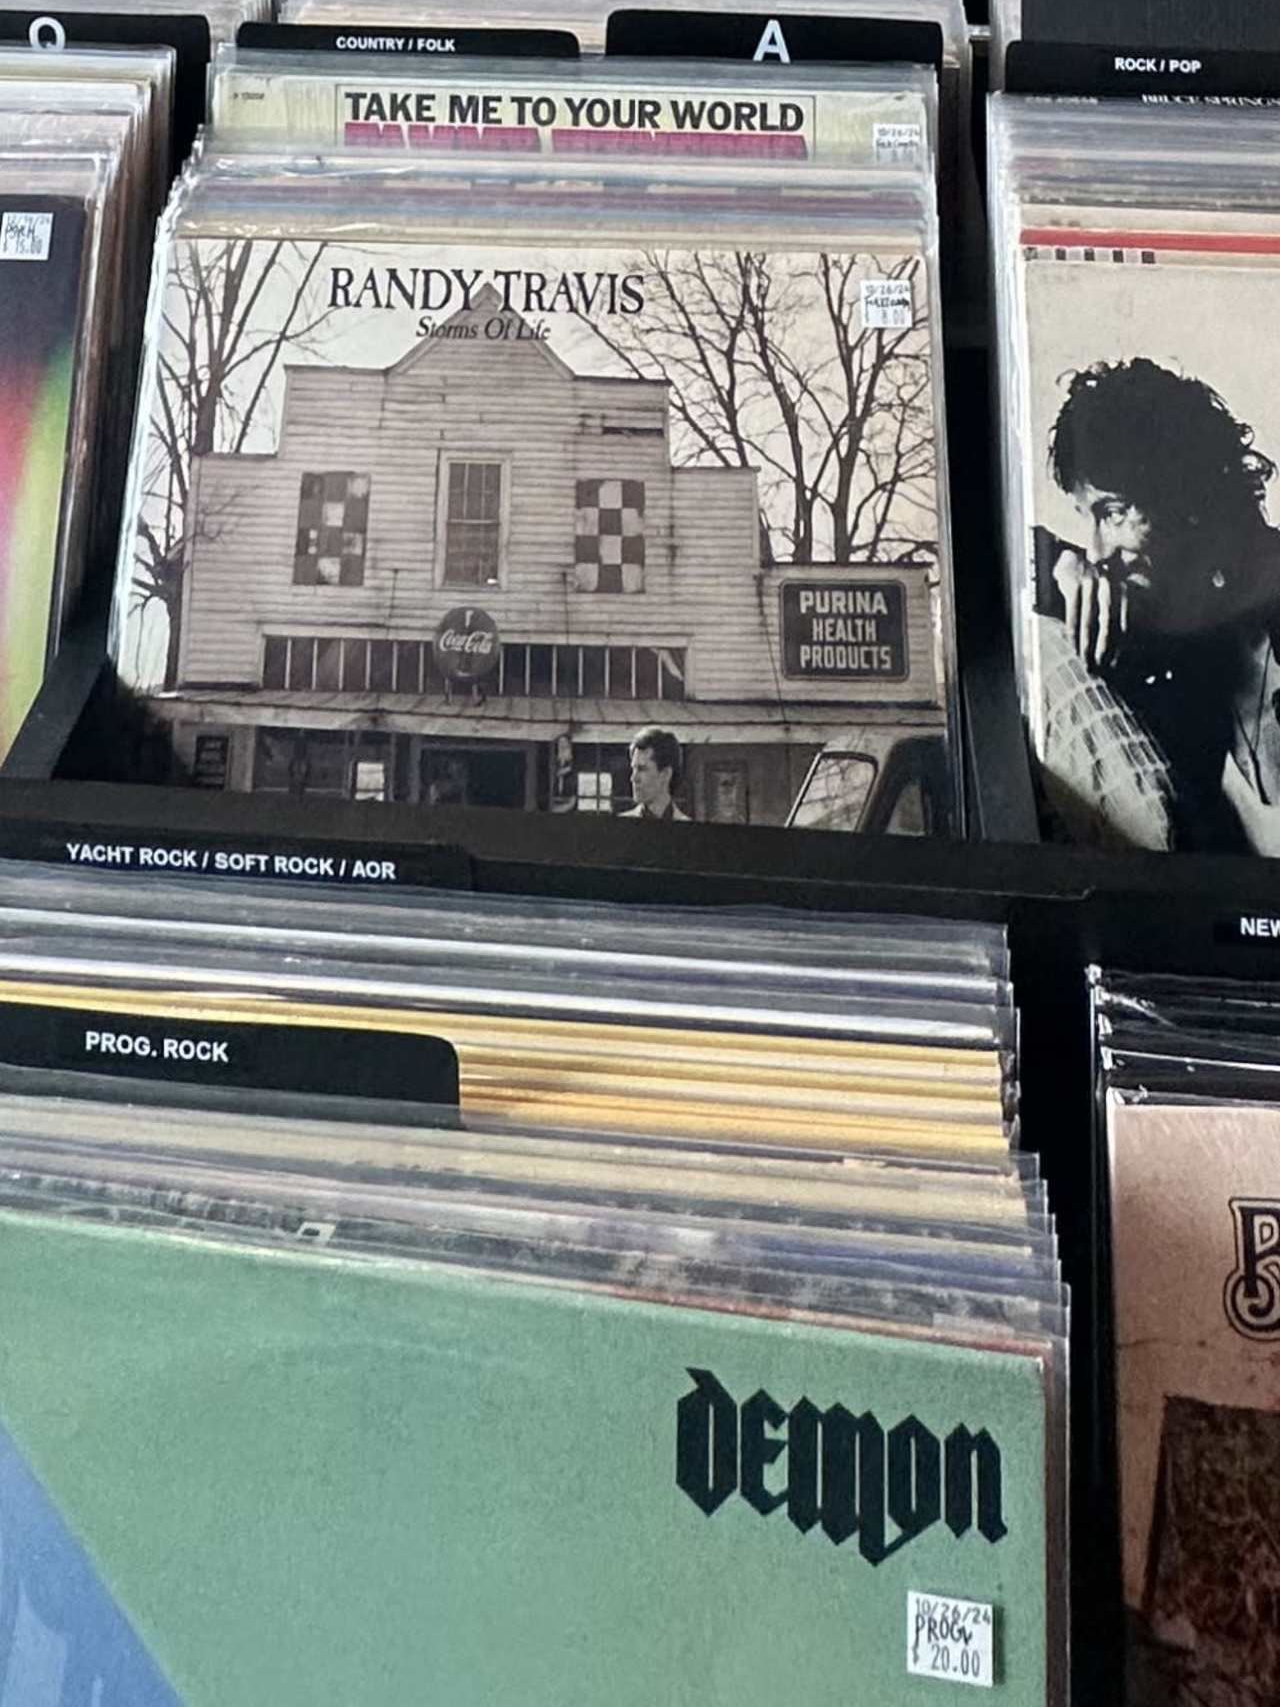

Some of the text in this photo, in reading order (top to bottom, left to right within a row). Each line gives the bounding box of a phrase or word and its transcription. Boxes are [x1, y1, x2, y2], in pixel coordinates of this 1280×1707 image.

[336, 36, 405, 50] COUNTRY
[417, 38, 456, 52] FOLK
[753, 20, 791, 64] A
[1114, 57, 1157, 72] ROCK
[1169, 59, 1202, 73] POP
[345, 92, 804, 132] TAKE ME TO YOUR WORLD
[327, 268, 644, 314] RANDY TRAVIS
[416, 316, 551, 340] Storms Of Life
[799, 590, 888, 615] PURINA
[812, 618, 877, 642] HEALTH
[800, 645, 892, 669] PRODUCTS
[67, 843, 134, 864] YACHT
[139, 848, 197, 868] ROCK
[214, 851, 269, 872] SOFT
[274, 855, 333, 876] ROCK
[351, 860, 396, 879] AOR
[85, 1031, 228, 1062] PROG. ROCK
[916, 1598, 991, 1625] 10/26/24
[931, 1644, 980, 1678] 20.00
